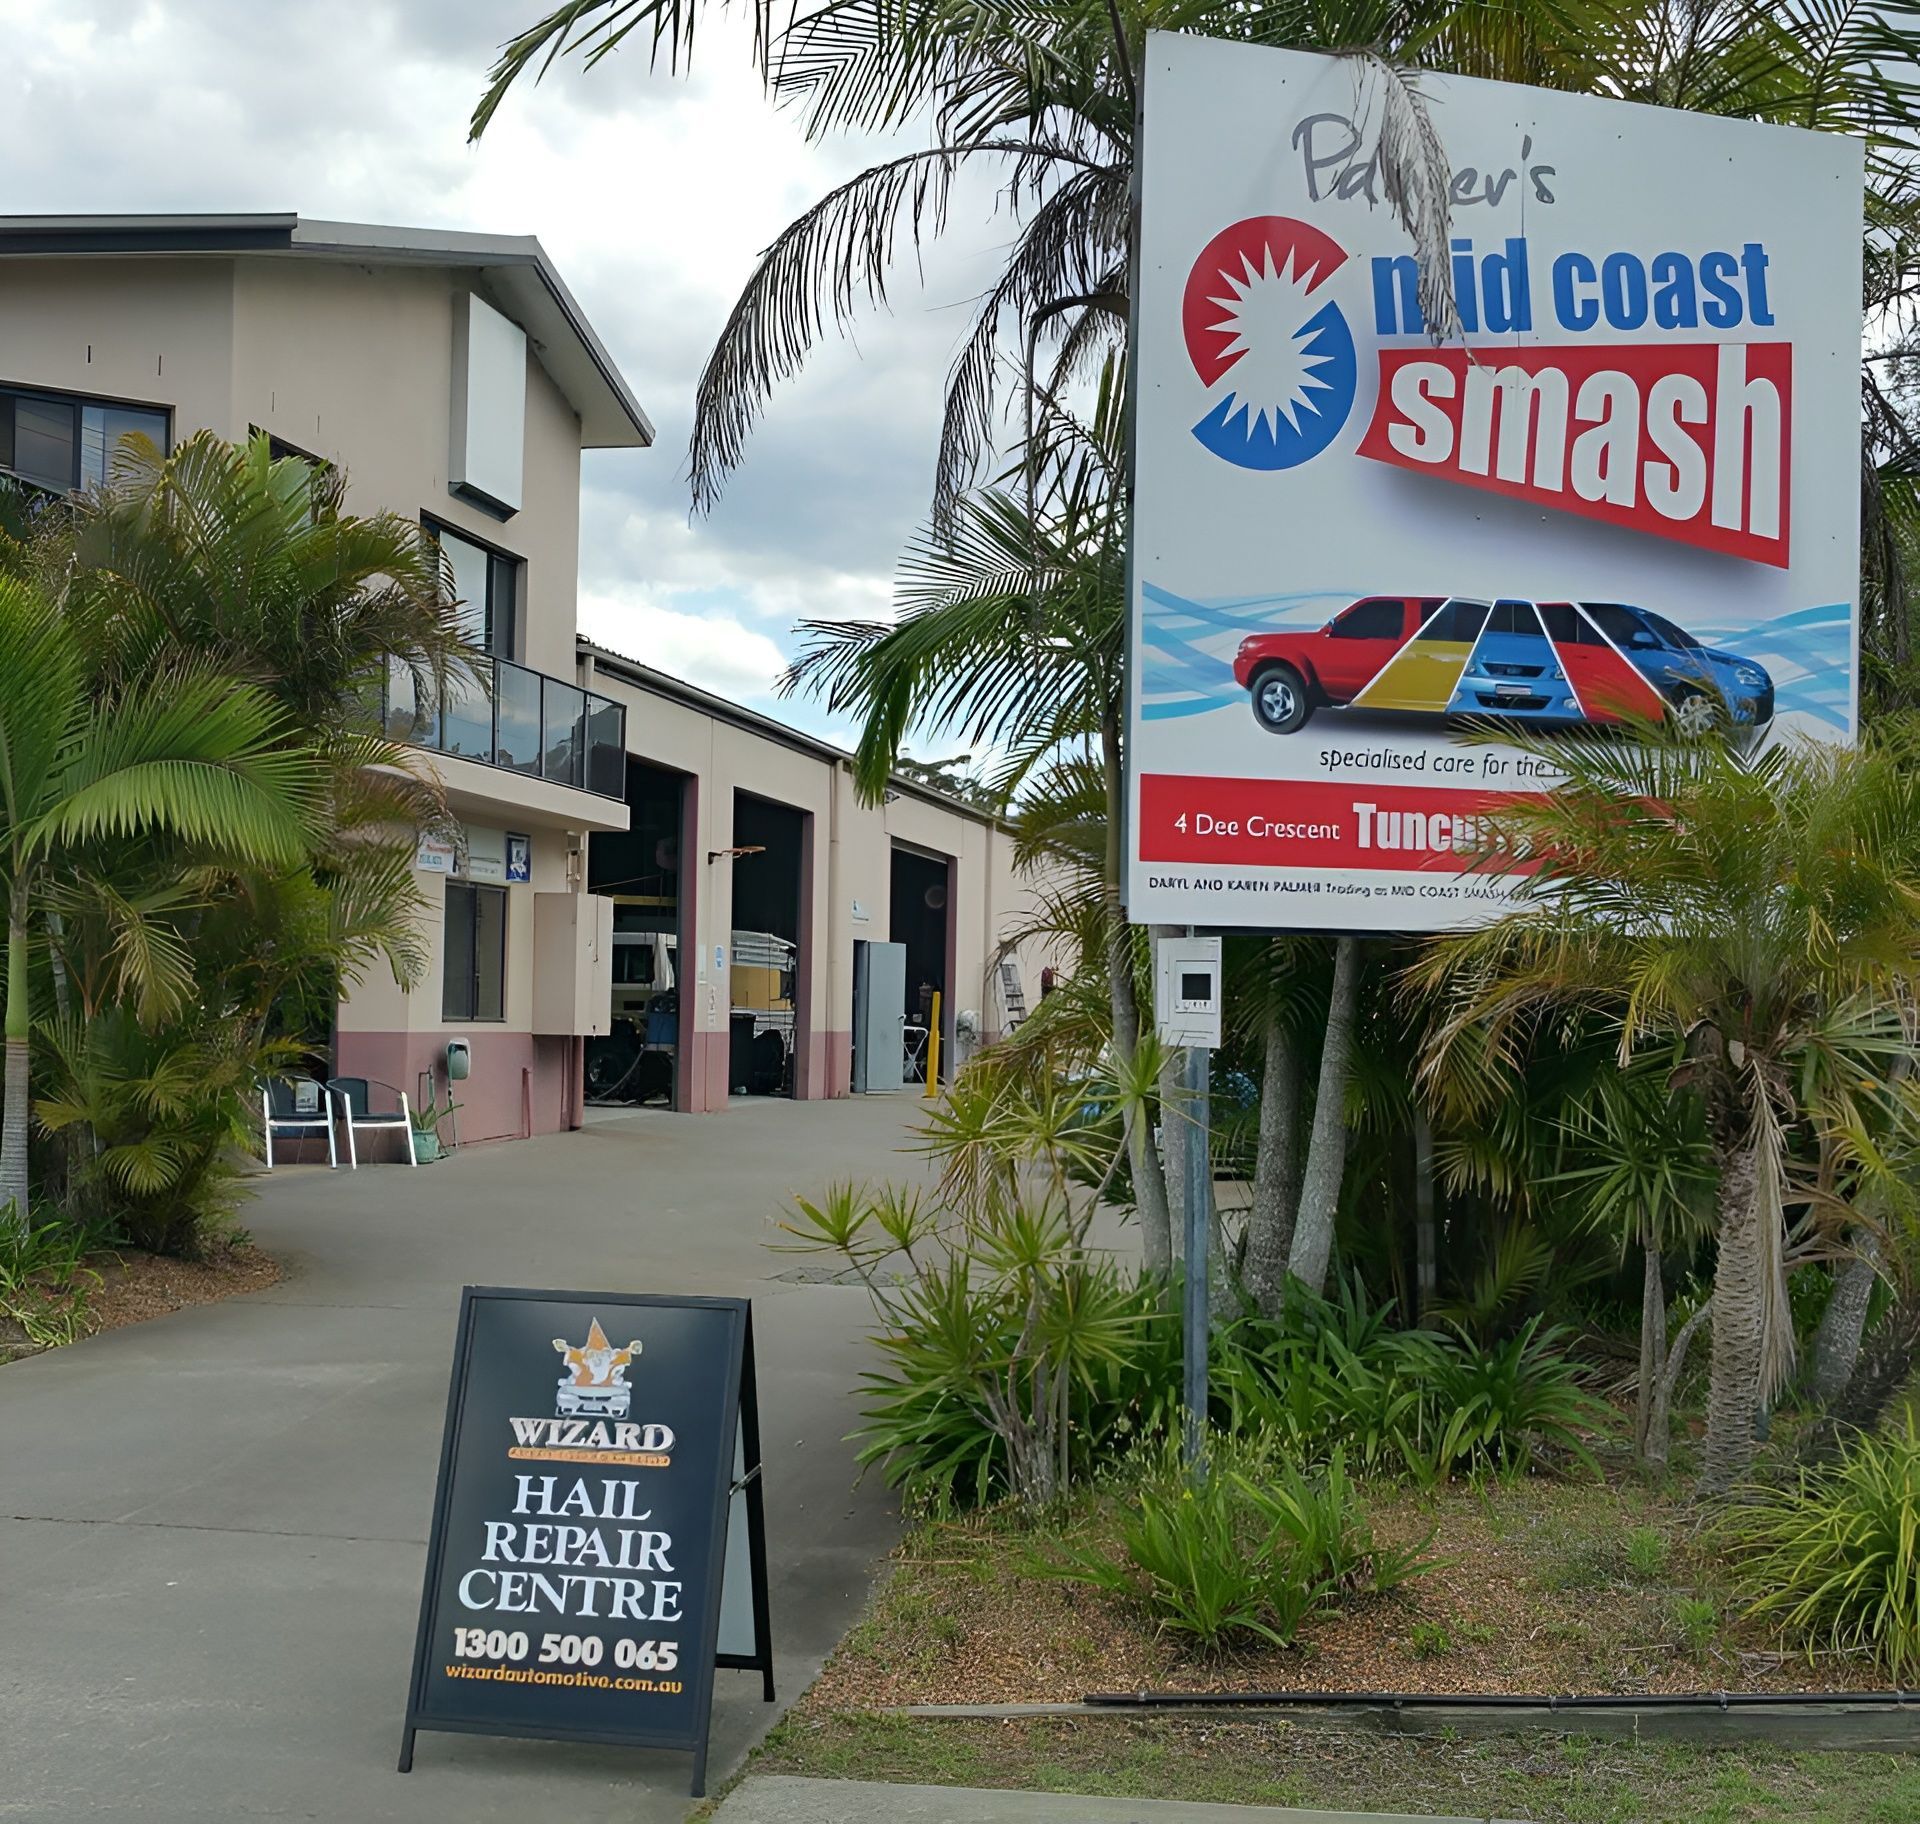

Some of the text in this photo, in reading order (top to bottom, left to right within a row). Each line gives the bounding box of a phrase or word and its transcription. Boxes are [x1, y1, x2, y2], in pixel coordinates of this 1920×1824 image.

[1292, 113, 1556, 207] Paer's
[1552, 243, 1774, 332] coast
[1387, 344, 1781, 541] smash
[1319, 748, 1427, 772] specialised
[1433, 754, 1475, 773] care
[1482, 753, 1509, 778] for
[1516, 756, 1545, 777] the
[1174, 812, 1188, 834] 4
[1196, 813, 1239, 836] Dee
[1246, 816, 1341, 840] Crescent
[1193, 879, 1223, 891] AND
[508, 1417, 677, 1451] WIZARD
[512, 1475, 652, 1521] HAIL
[481, 1521, 675, 1573] REPAIR
[458, 1569, 683, 1622] CENTRE
[454, 1628, 678, 1671] 1300 500 065
[446, 1664, 683, 1694] wizardautomotive.com.au
